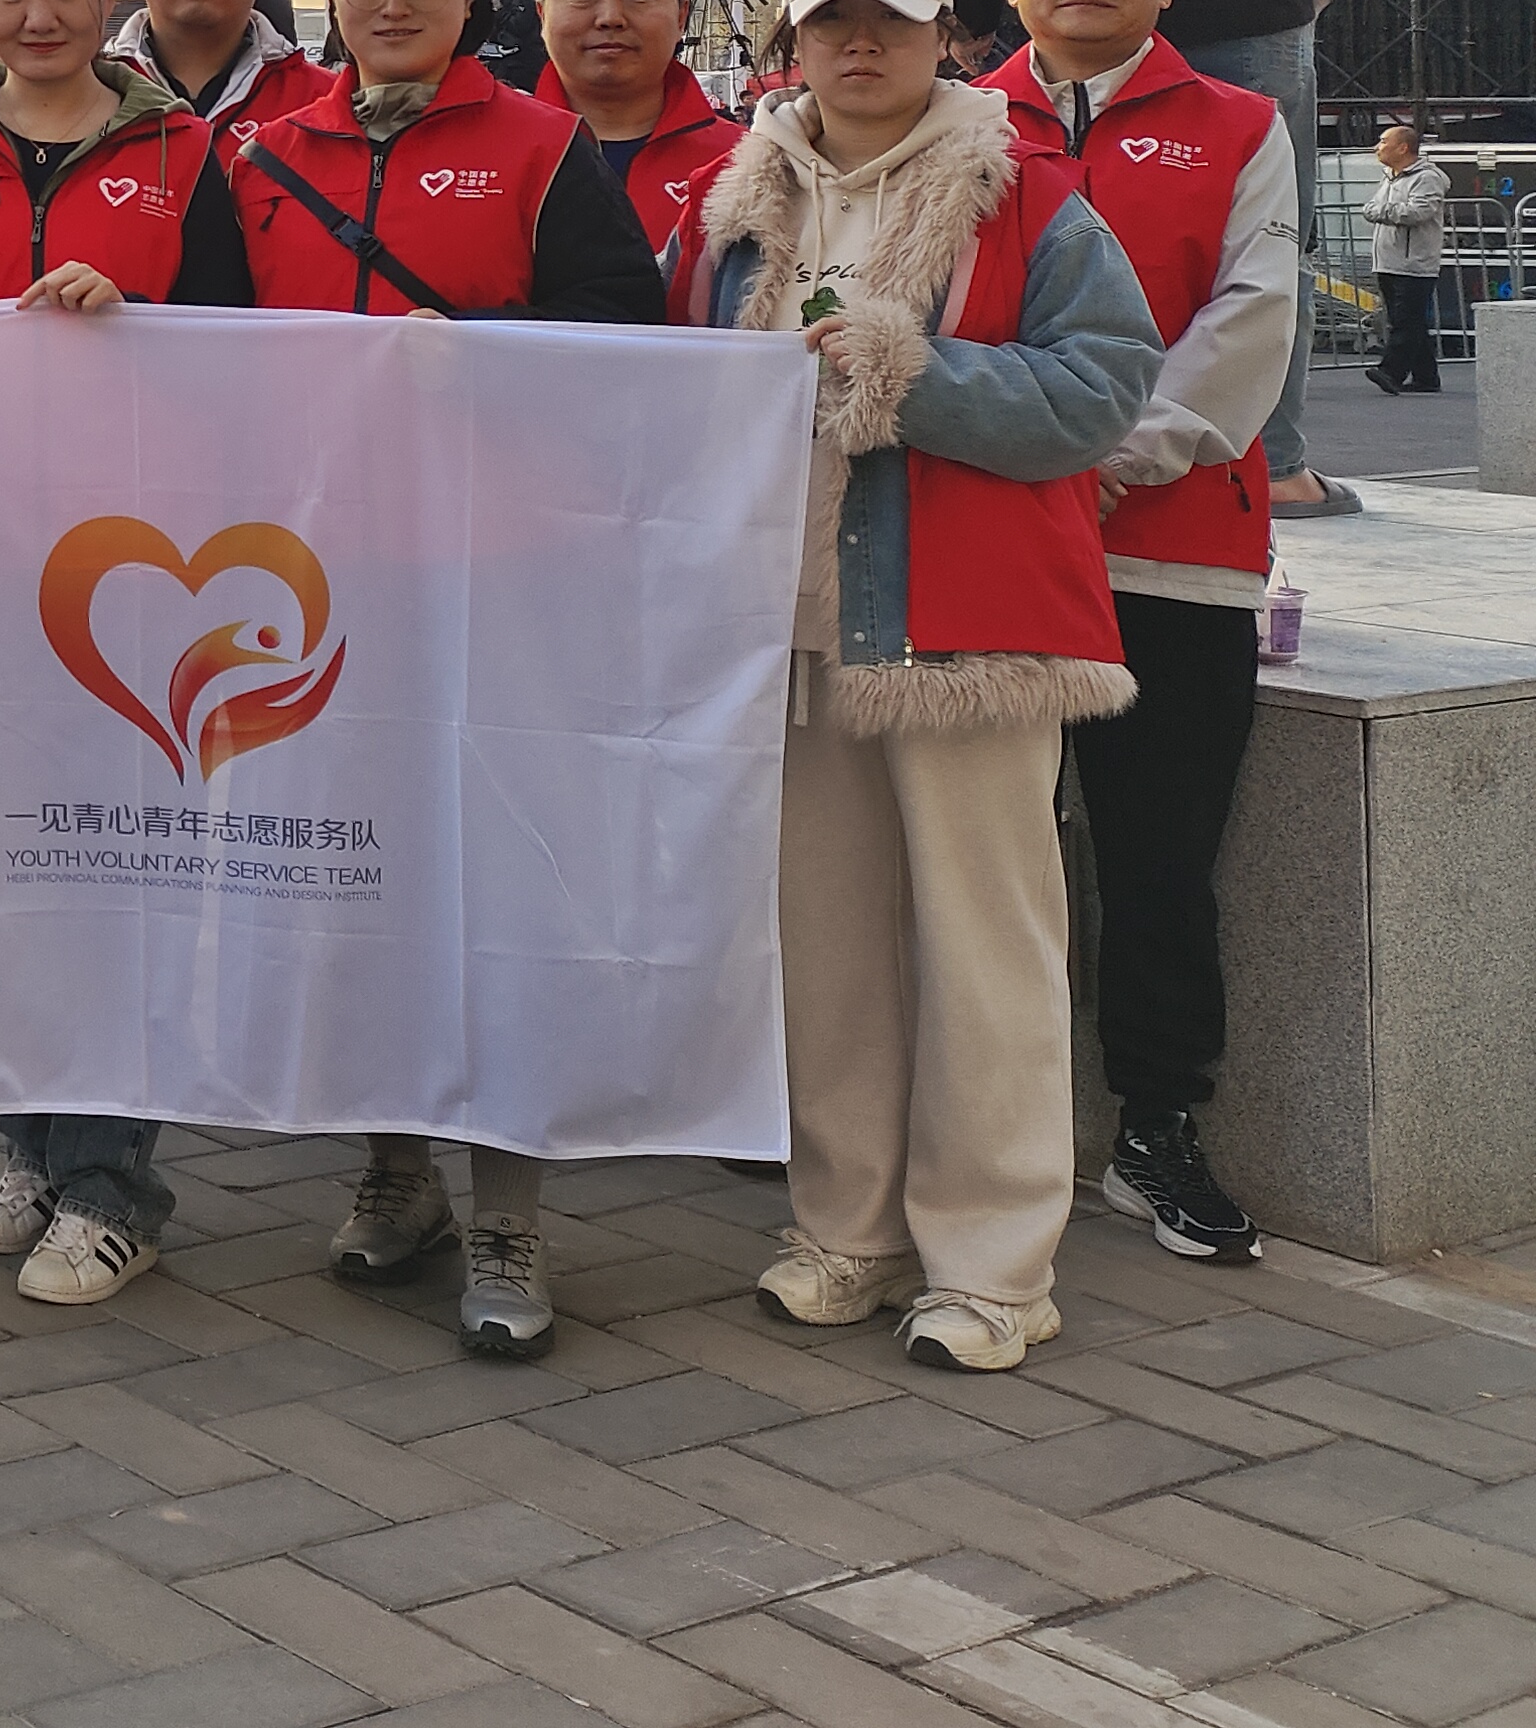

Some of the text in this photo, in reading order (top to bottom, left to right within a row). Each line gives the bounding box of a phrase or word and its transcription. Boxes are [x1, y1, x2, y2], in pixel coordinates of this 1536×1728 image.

[5, 803, 381, 851] 一见青心青年志愿服务队
[6, 850, 382, 885] YOUTH VOLUNTARY SERVICE TEAM
[6, 874, 382, 901] HEBEI PROVINCIAL COMMUNICATIONS PLANNING AND DESIGN INSTITUTE
